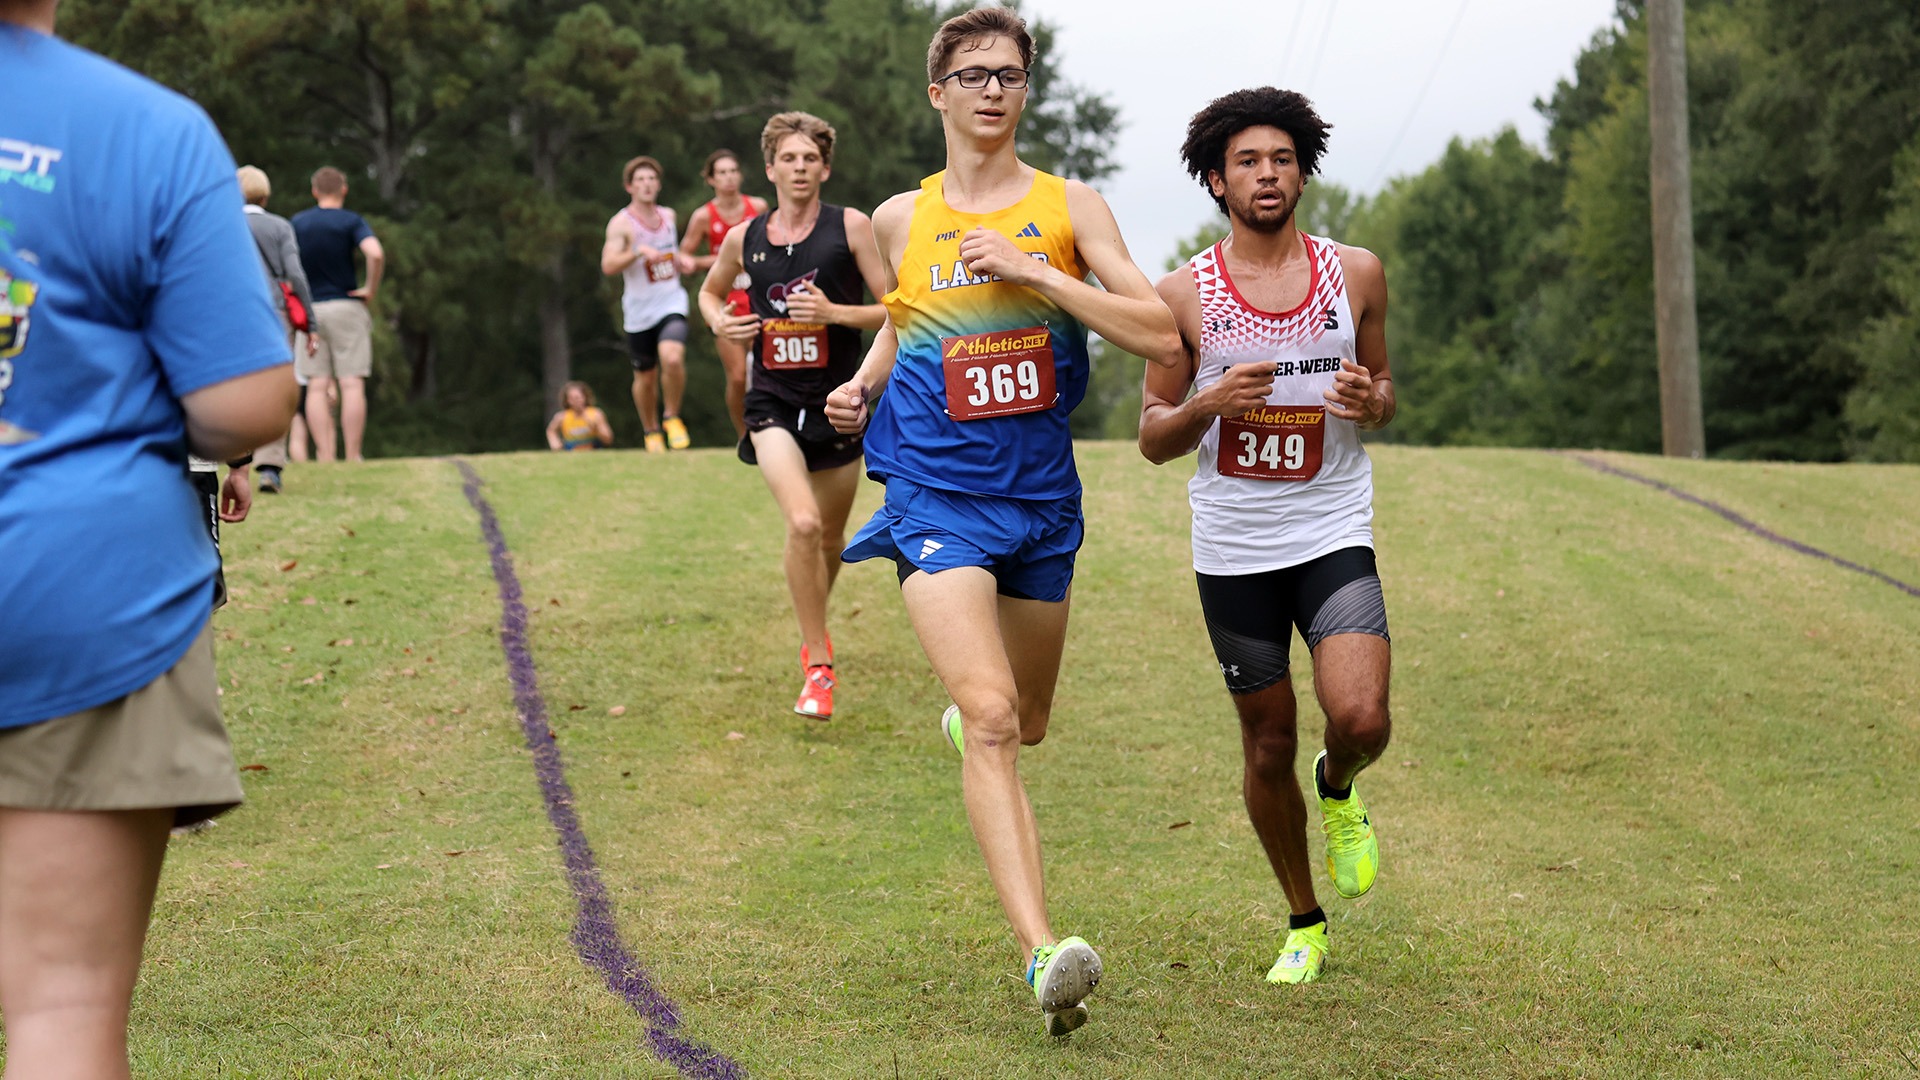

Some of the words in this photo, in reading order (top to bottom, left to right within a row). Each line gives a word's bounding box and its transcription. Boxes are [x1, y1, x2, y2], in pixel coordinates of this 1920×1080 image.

[935, 229, 960, 242] PBC
[772, 336, 819, 363] 305
[965, 360, 1040, 407] 369
[1237, 431, 1305, 470] 349
